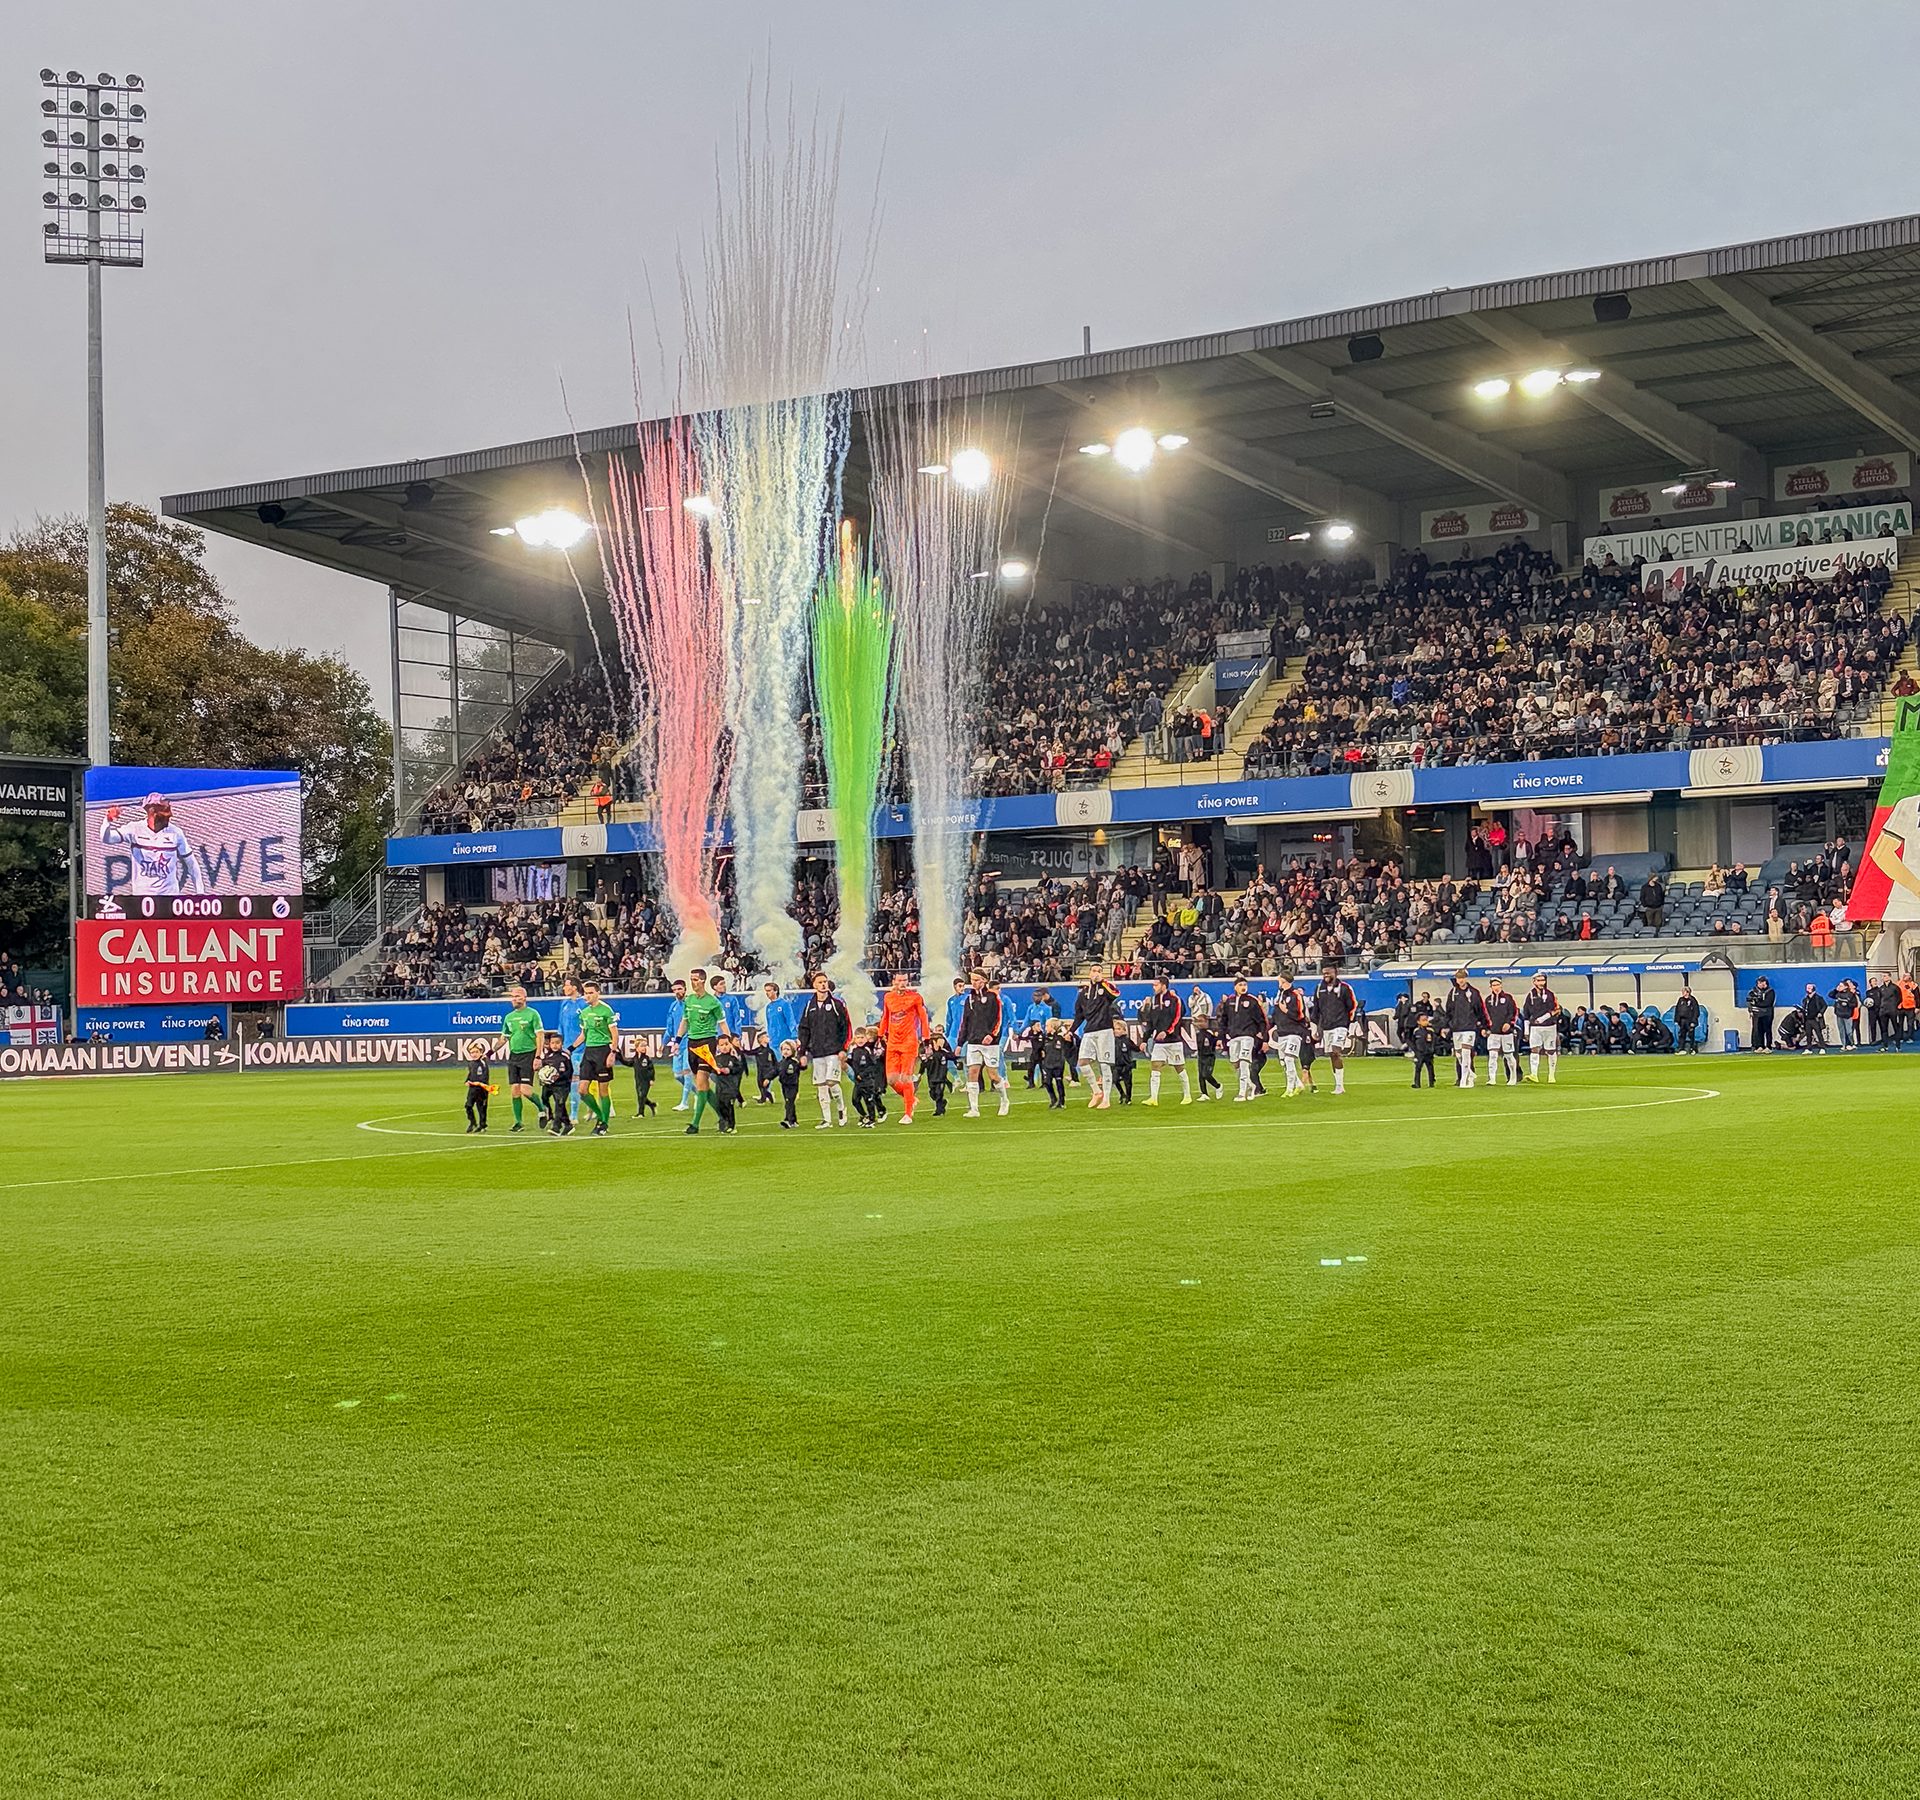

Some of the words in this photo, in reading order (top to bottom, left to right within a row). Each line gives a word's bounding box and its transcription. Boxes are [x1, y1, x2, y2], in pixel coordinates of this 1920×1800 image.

[1269, 530, 1285, 540] 322
[1616, 523, 1772, 561] TUINCENTRUM
[1780, 509, 1910, 543] BOTANICA
[1513, 776, 1541, 788] KING
[1544, 775, 1583, 787] POWER
[1197, 798, 1222, 809] KING
[1224, 796, 1259, 807] POWER
[945, 814, 976, 824] POWER
[453, 846, 471, 855] KING
[472, 844, 497, 853] POWER
[141, 897, 155, 917] 0
[172, 898, 222, 916] 00:00
[238, 897, 252, 917] 0
[98, 928, 285, 964] CALLANT
[101, 970, 284, 996] INSURANCE
[86, 1022, 111, 1030] KING
[113, 1021, 145, 1029] POWER
[162, 1020, 188, 1028] KING
[342, 1018, 362, 1027] KING
[363, 1018, 390, 1027] POWER
[475, 1015, 502, 1024] POWER
[0, 1048, 97, 1072] OMAAN
[102, 1044, 210, 1069] LEUVEN!
[245, 1040, 342, 1065] KOMAAN
[347, 1038, 432, 1063] LEUVEN!
